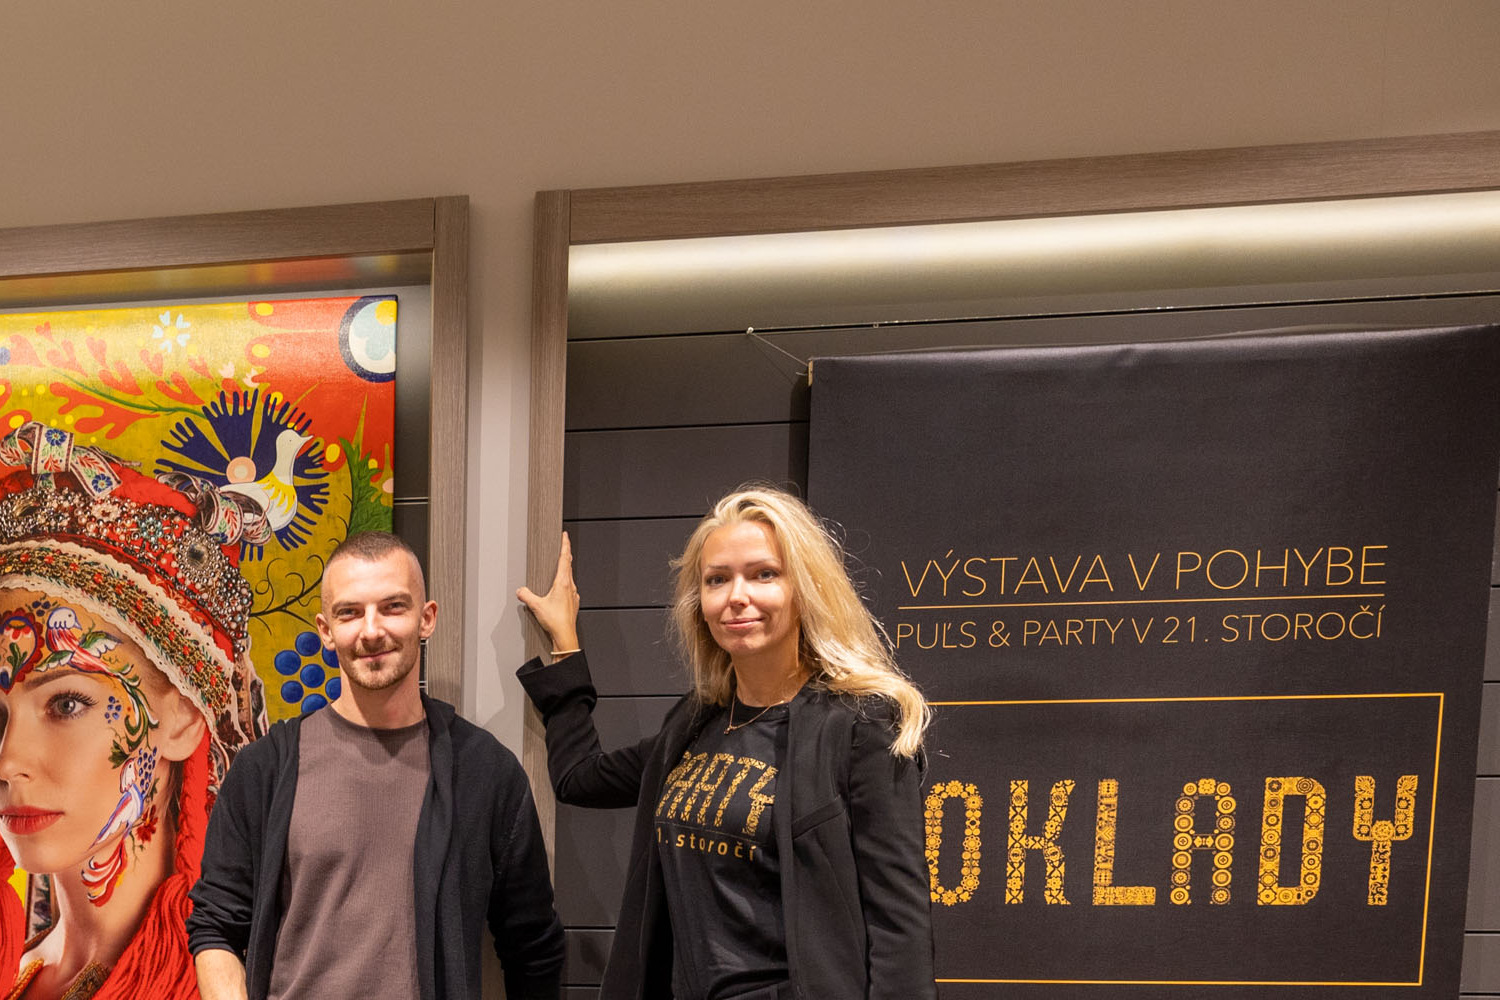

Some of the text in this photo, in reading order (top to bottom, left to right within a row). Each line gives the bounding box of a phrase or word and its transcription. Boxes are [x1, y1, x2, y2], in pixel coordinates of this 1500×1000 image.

[900, 544, 1389, 598] VÝSTAVA V POHYBE
[896, 603, 1387, 649] PUĽS & PARTY V 21. STOROČÍ
[655, 827, 669, 845] 1.
[924, 774, 1419, 907] OKLADY
